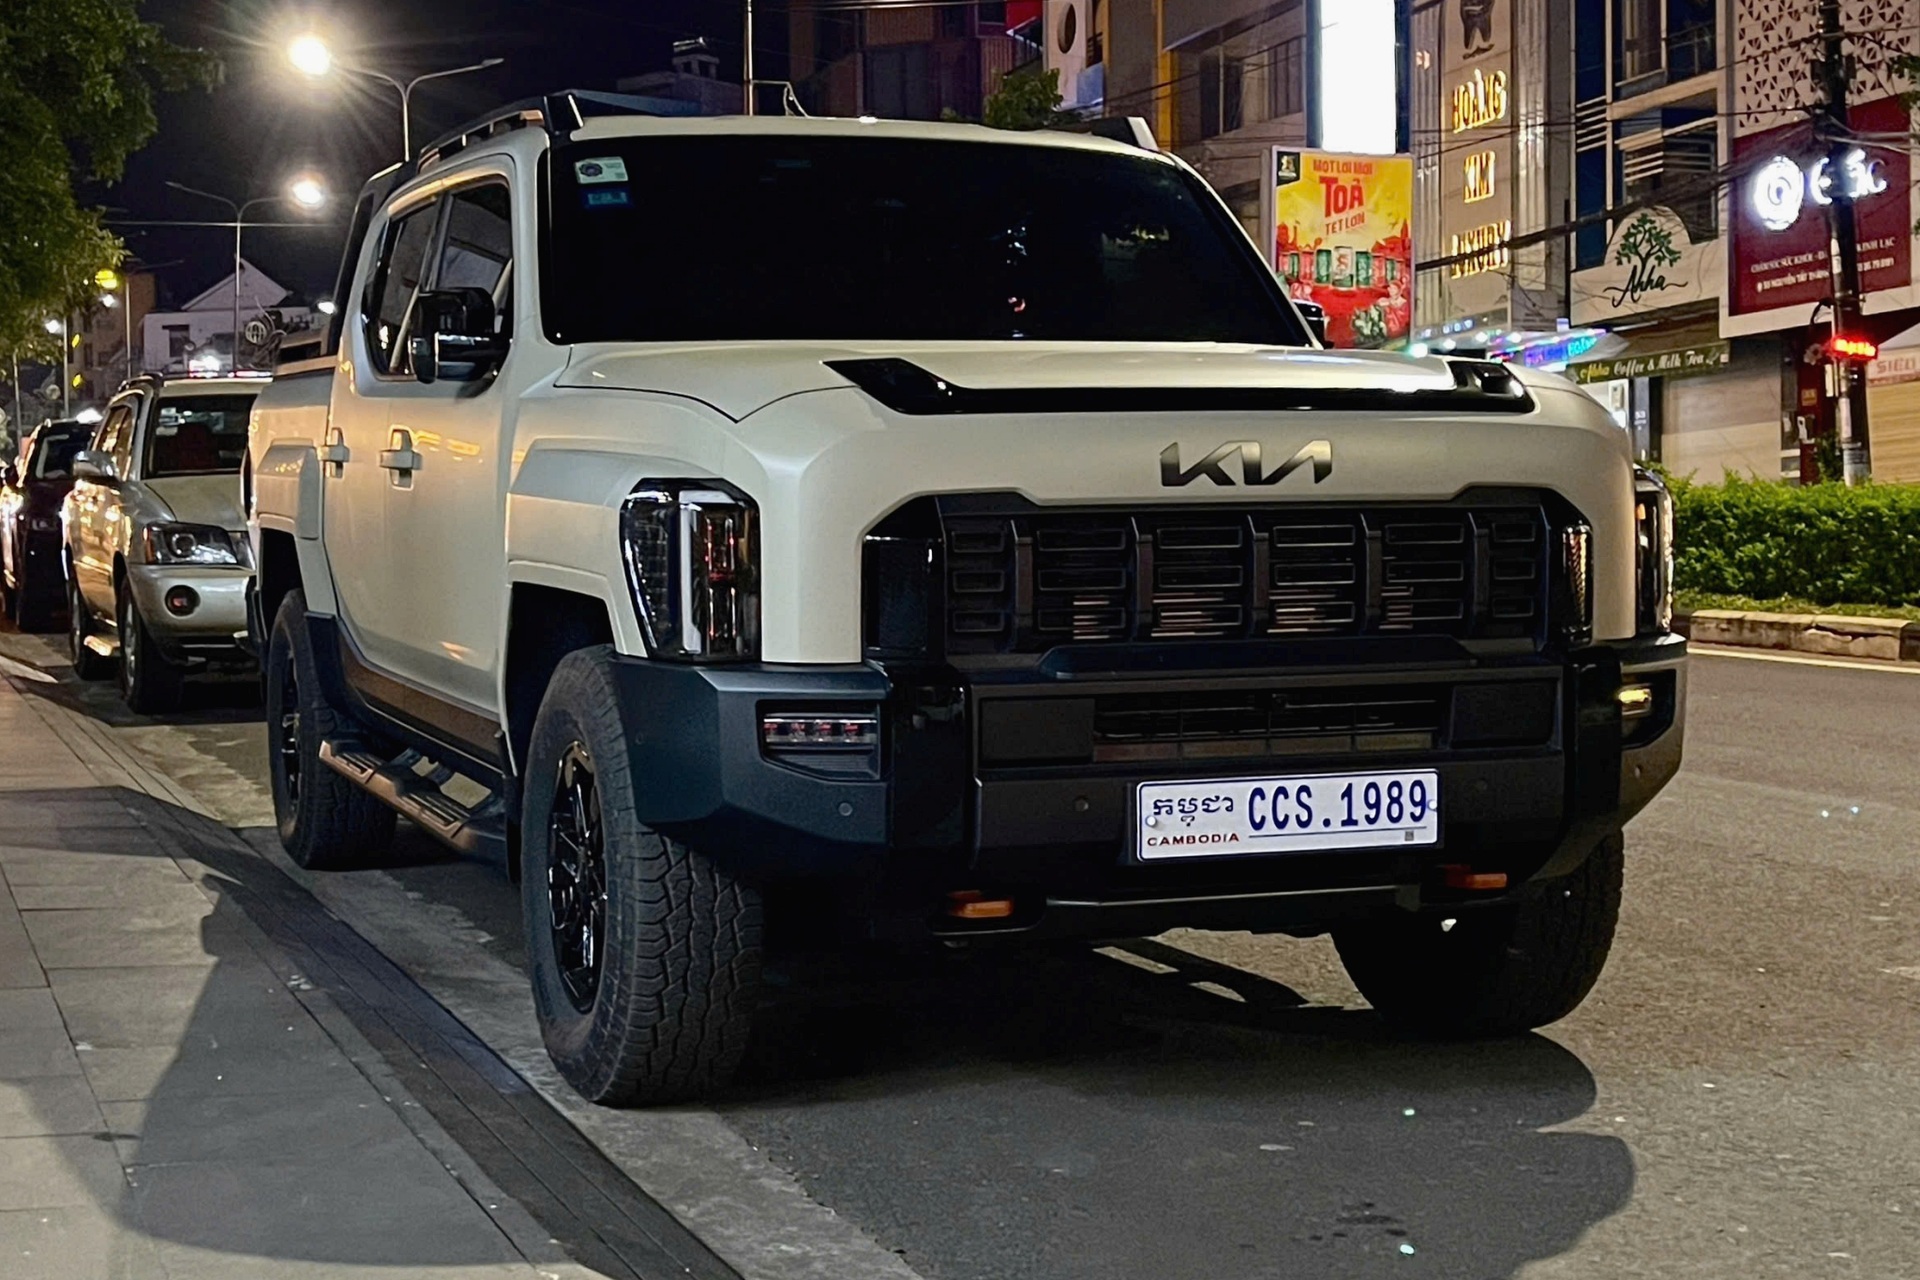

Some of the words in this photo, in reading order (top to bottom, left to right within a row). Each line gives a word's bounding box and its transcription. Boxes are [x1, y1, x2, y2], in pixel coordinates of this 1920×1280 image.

[1463, 151, 1496, 204] KIM
[1614, 359, 1645, 377] Coffee
[1647, 361, 1655, 371] &
[1657, 353, 1682, 370] Milk
[1684, 350, 1704, 366] Tea
[1160, 440, 1332, 486] KIA
[1248, 779, 1427, 831] CCS.1989
[1147, 833, 1240, 847] CAMBODIA
